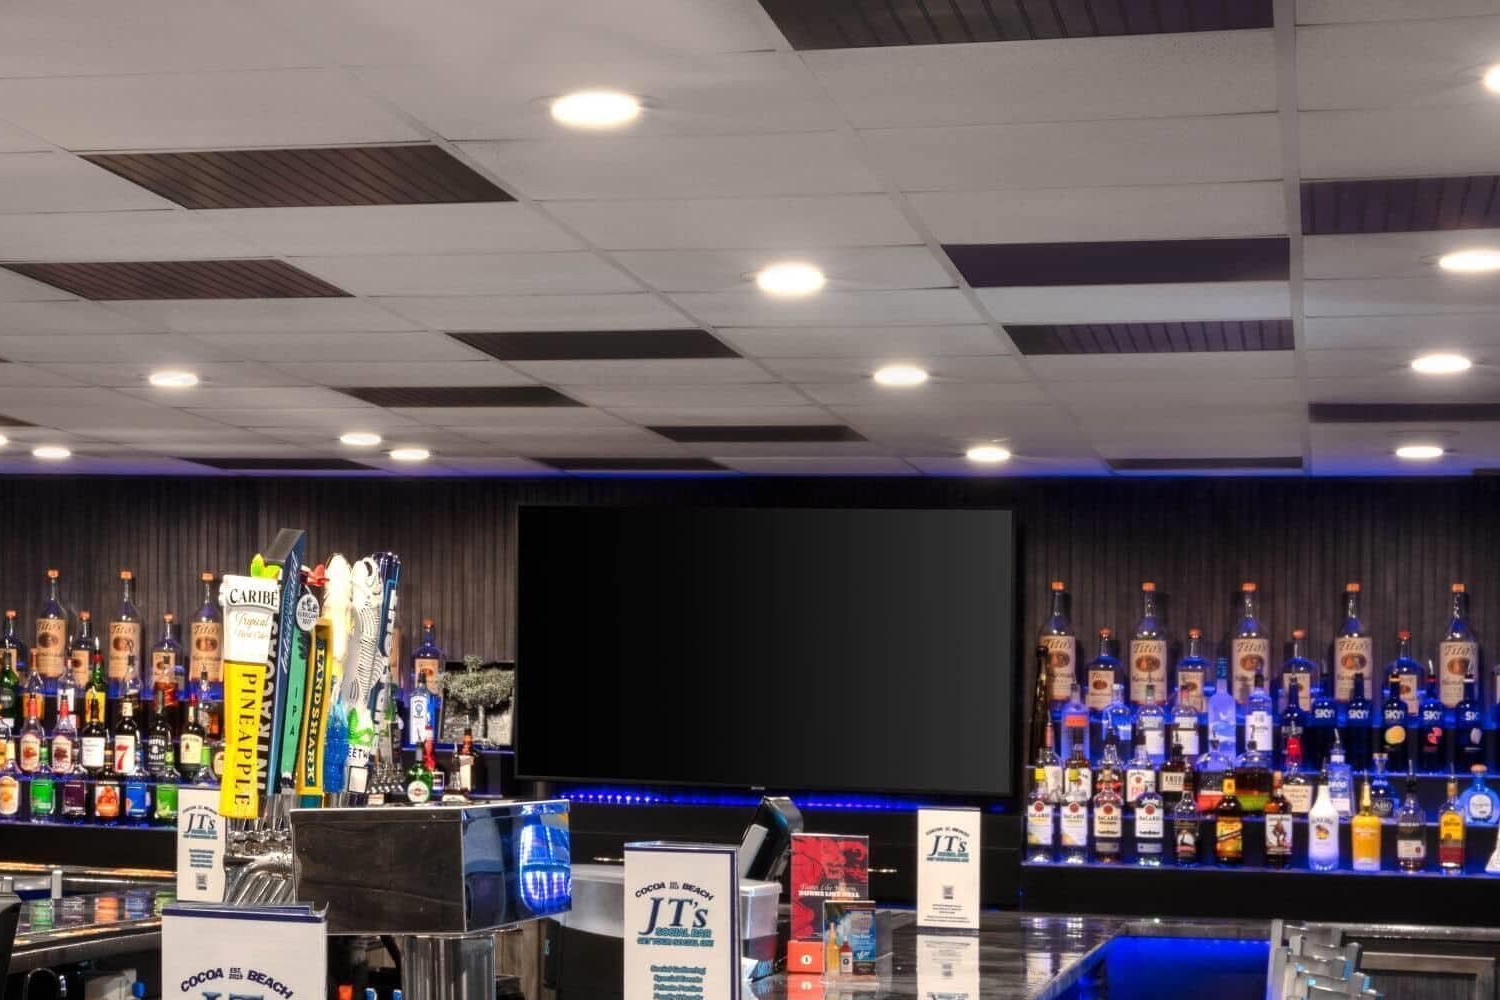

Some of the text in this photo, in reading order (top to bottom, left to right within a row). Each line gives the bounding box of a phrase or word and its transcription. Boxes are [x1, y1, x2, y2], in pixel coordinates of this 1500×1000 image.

[307, 648, 326, 784] LANDSHARK
[234, 673, 257, 805] PINEAPPLE
[926, 835, 967, 856] JT's
[635, 881, 666, 898] COCOA
[682, 882, 715, 901] BEACH
[638, 896, 709, 936] JT's
[180, 967, 294, 1000] COCOA BEACH
